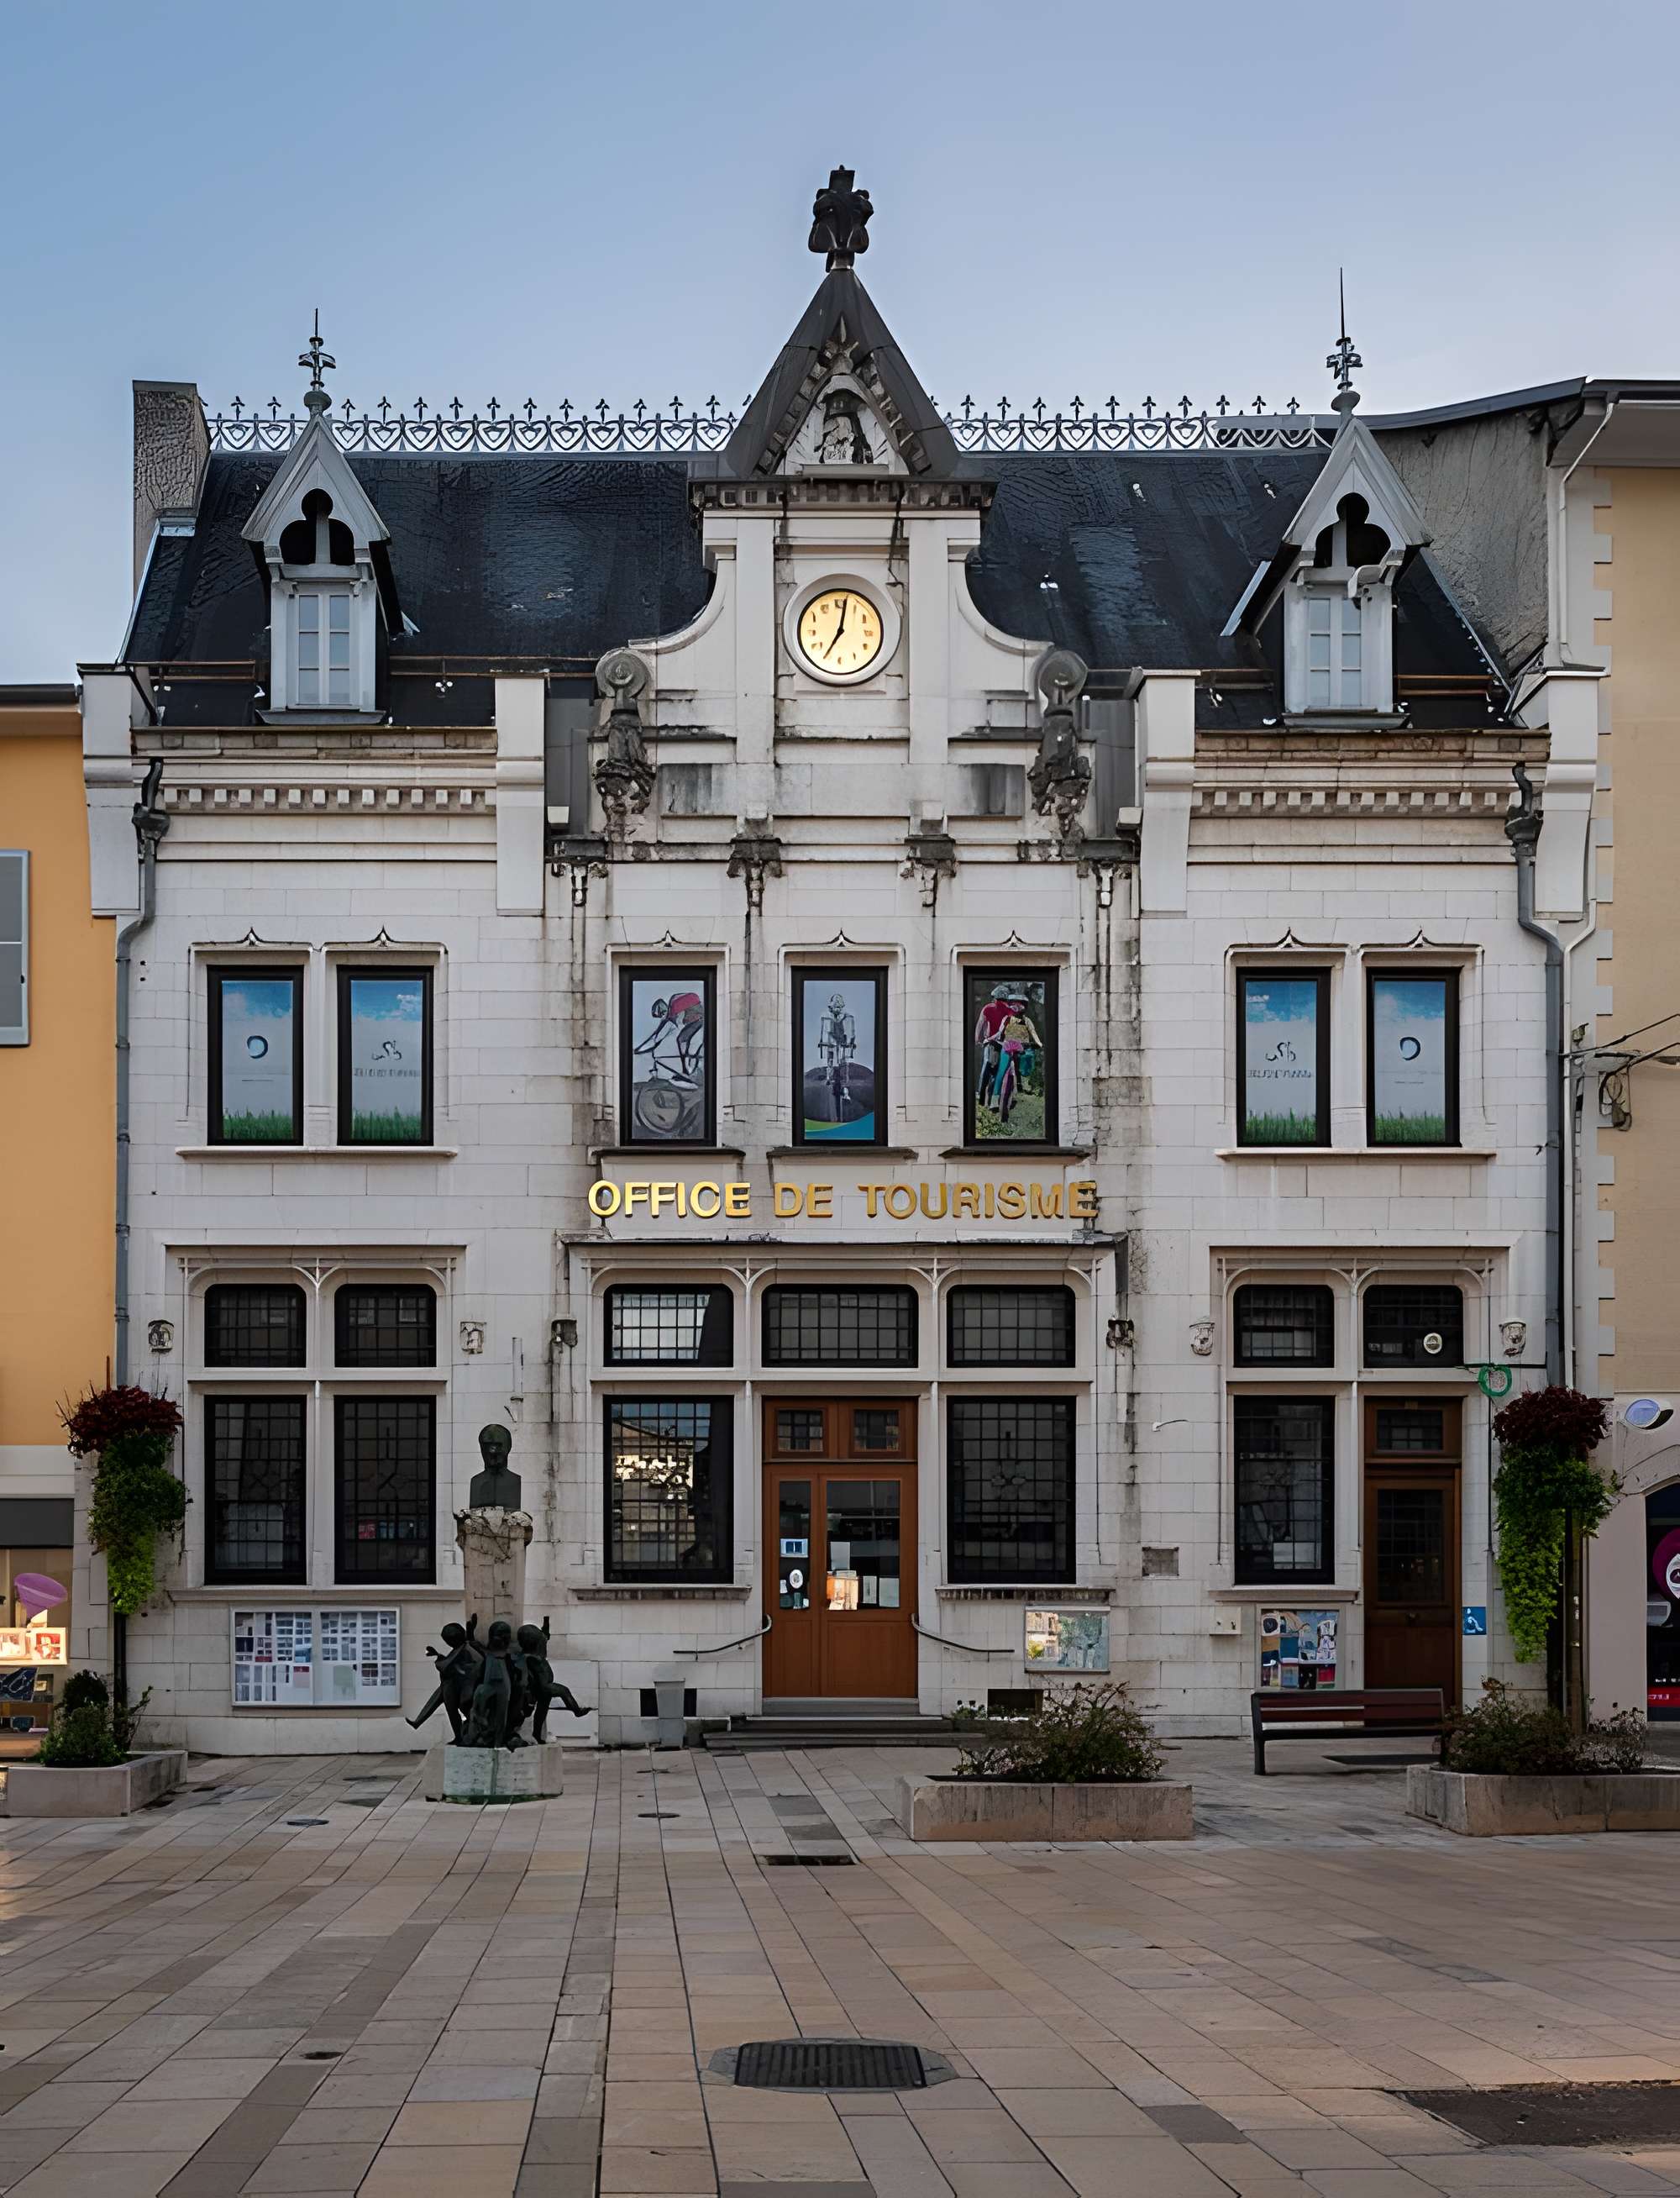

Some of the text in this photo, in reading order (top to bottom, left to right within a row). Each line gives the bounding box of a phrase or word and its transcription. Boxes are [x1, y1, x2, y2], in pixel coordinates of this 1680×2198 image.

[588, 1180, 1099, 1219] OFFICE DE TOURISME
